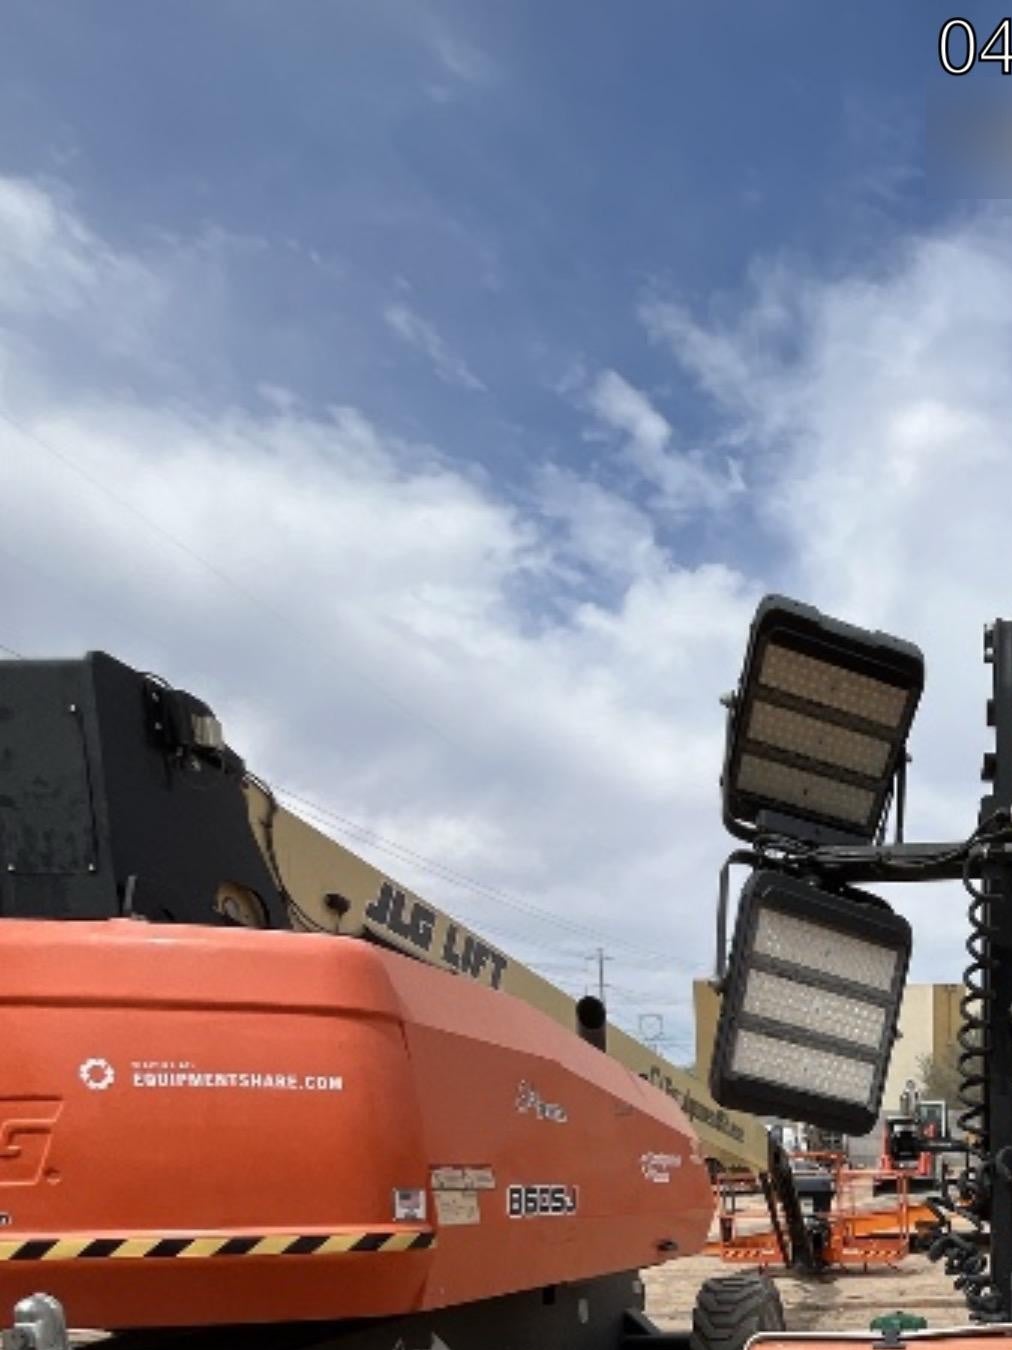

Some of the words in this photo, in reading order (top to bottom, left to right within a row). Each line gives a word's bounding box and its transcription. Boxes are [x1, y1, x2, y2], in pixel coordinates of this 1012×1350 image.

[366, 882, 436, 952] JLG
[443, 923, 508, 991] LIFT
[132, 1072, 344, 1091] EQUIPMENTSHARE.COM
